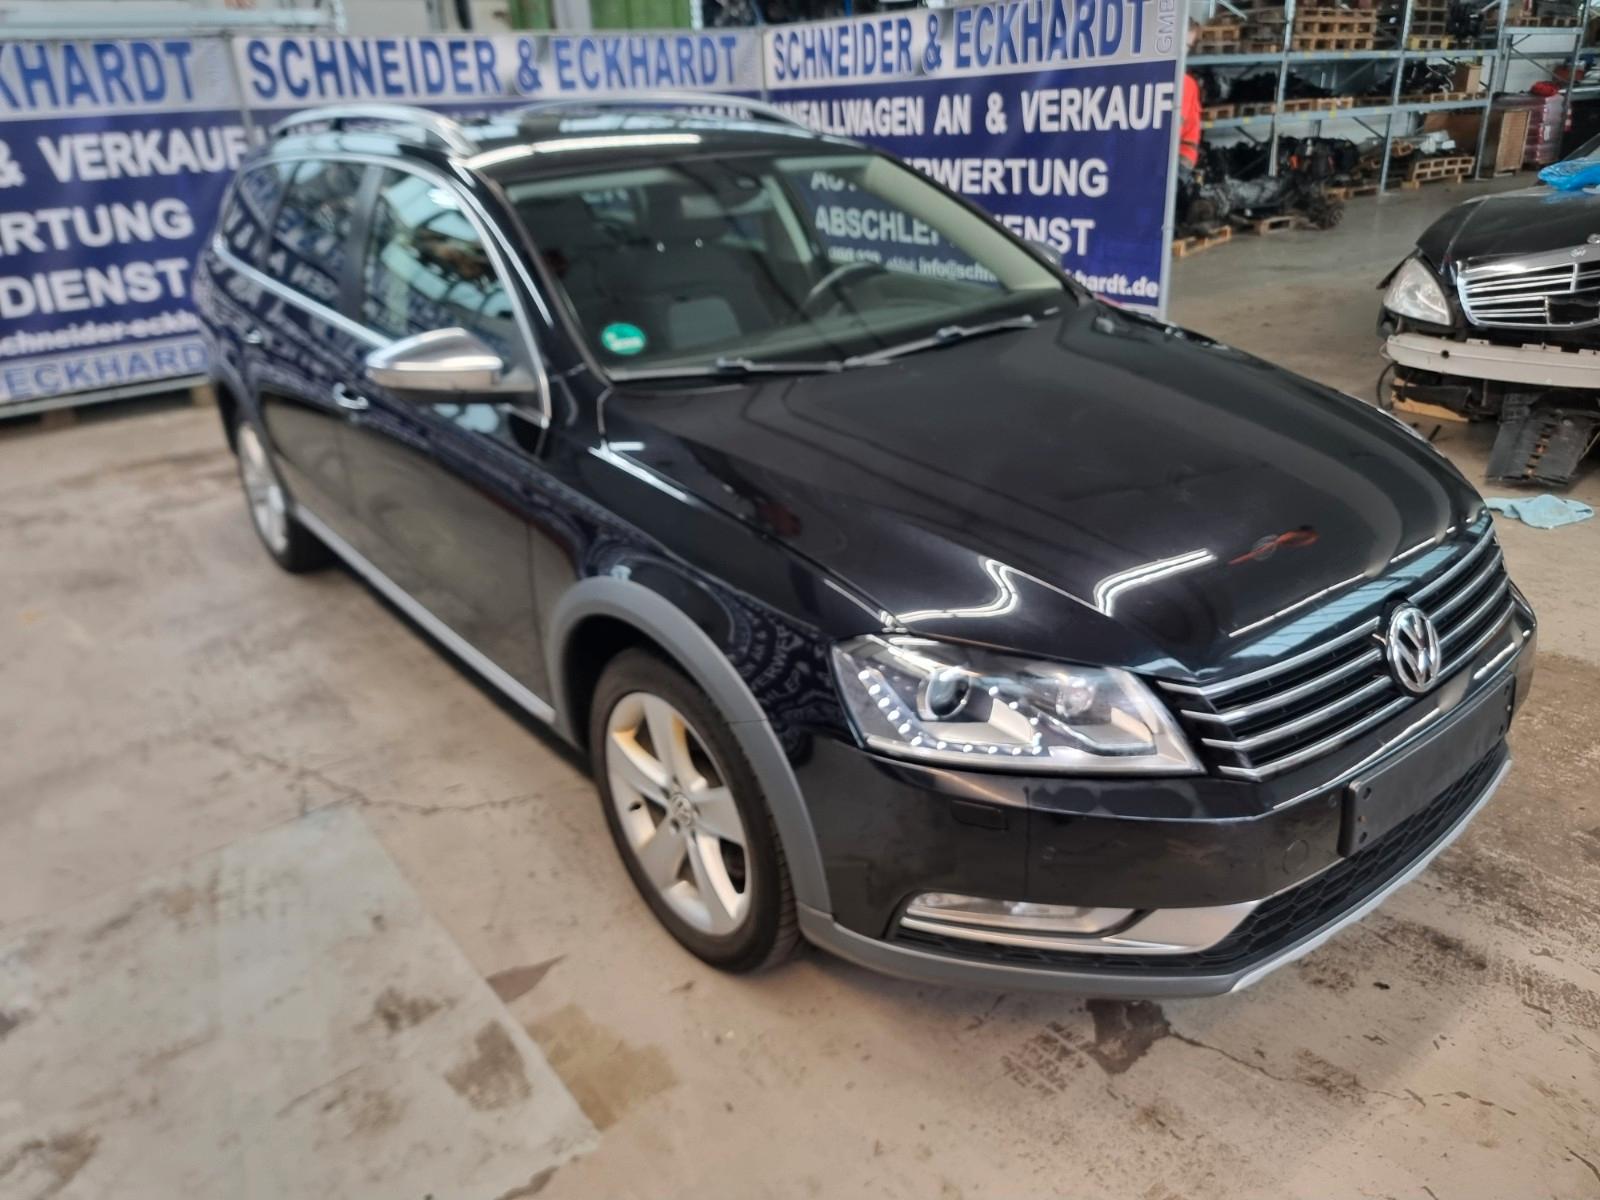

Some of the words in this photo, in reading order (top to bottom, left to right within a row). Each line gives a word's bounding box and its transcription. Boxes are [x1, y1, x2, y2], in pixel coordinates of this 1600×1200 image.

[246, 38, 498, 99] SCHNEIDER
[516, 37, 543, 91] &
[552, 36, 737, 92] ECKHARDT
[773, 18, 913, 81] SCHNEIDER
[923, 13, 943, 71] &
[954, 0, 1152, 69] ECKHARDT
[934, 94, 971, 135] AN
[986, 91, 1007, 134] &
[1021, 82, 1176, 132] VERKAUF
[36, 125, 249, 184] VERKAUF
[0, 197, 195, 257] RTUNG
[0, 257, 191, 319] DIENST
